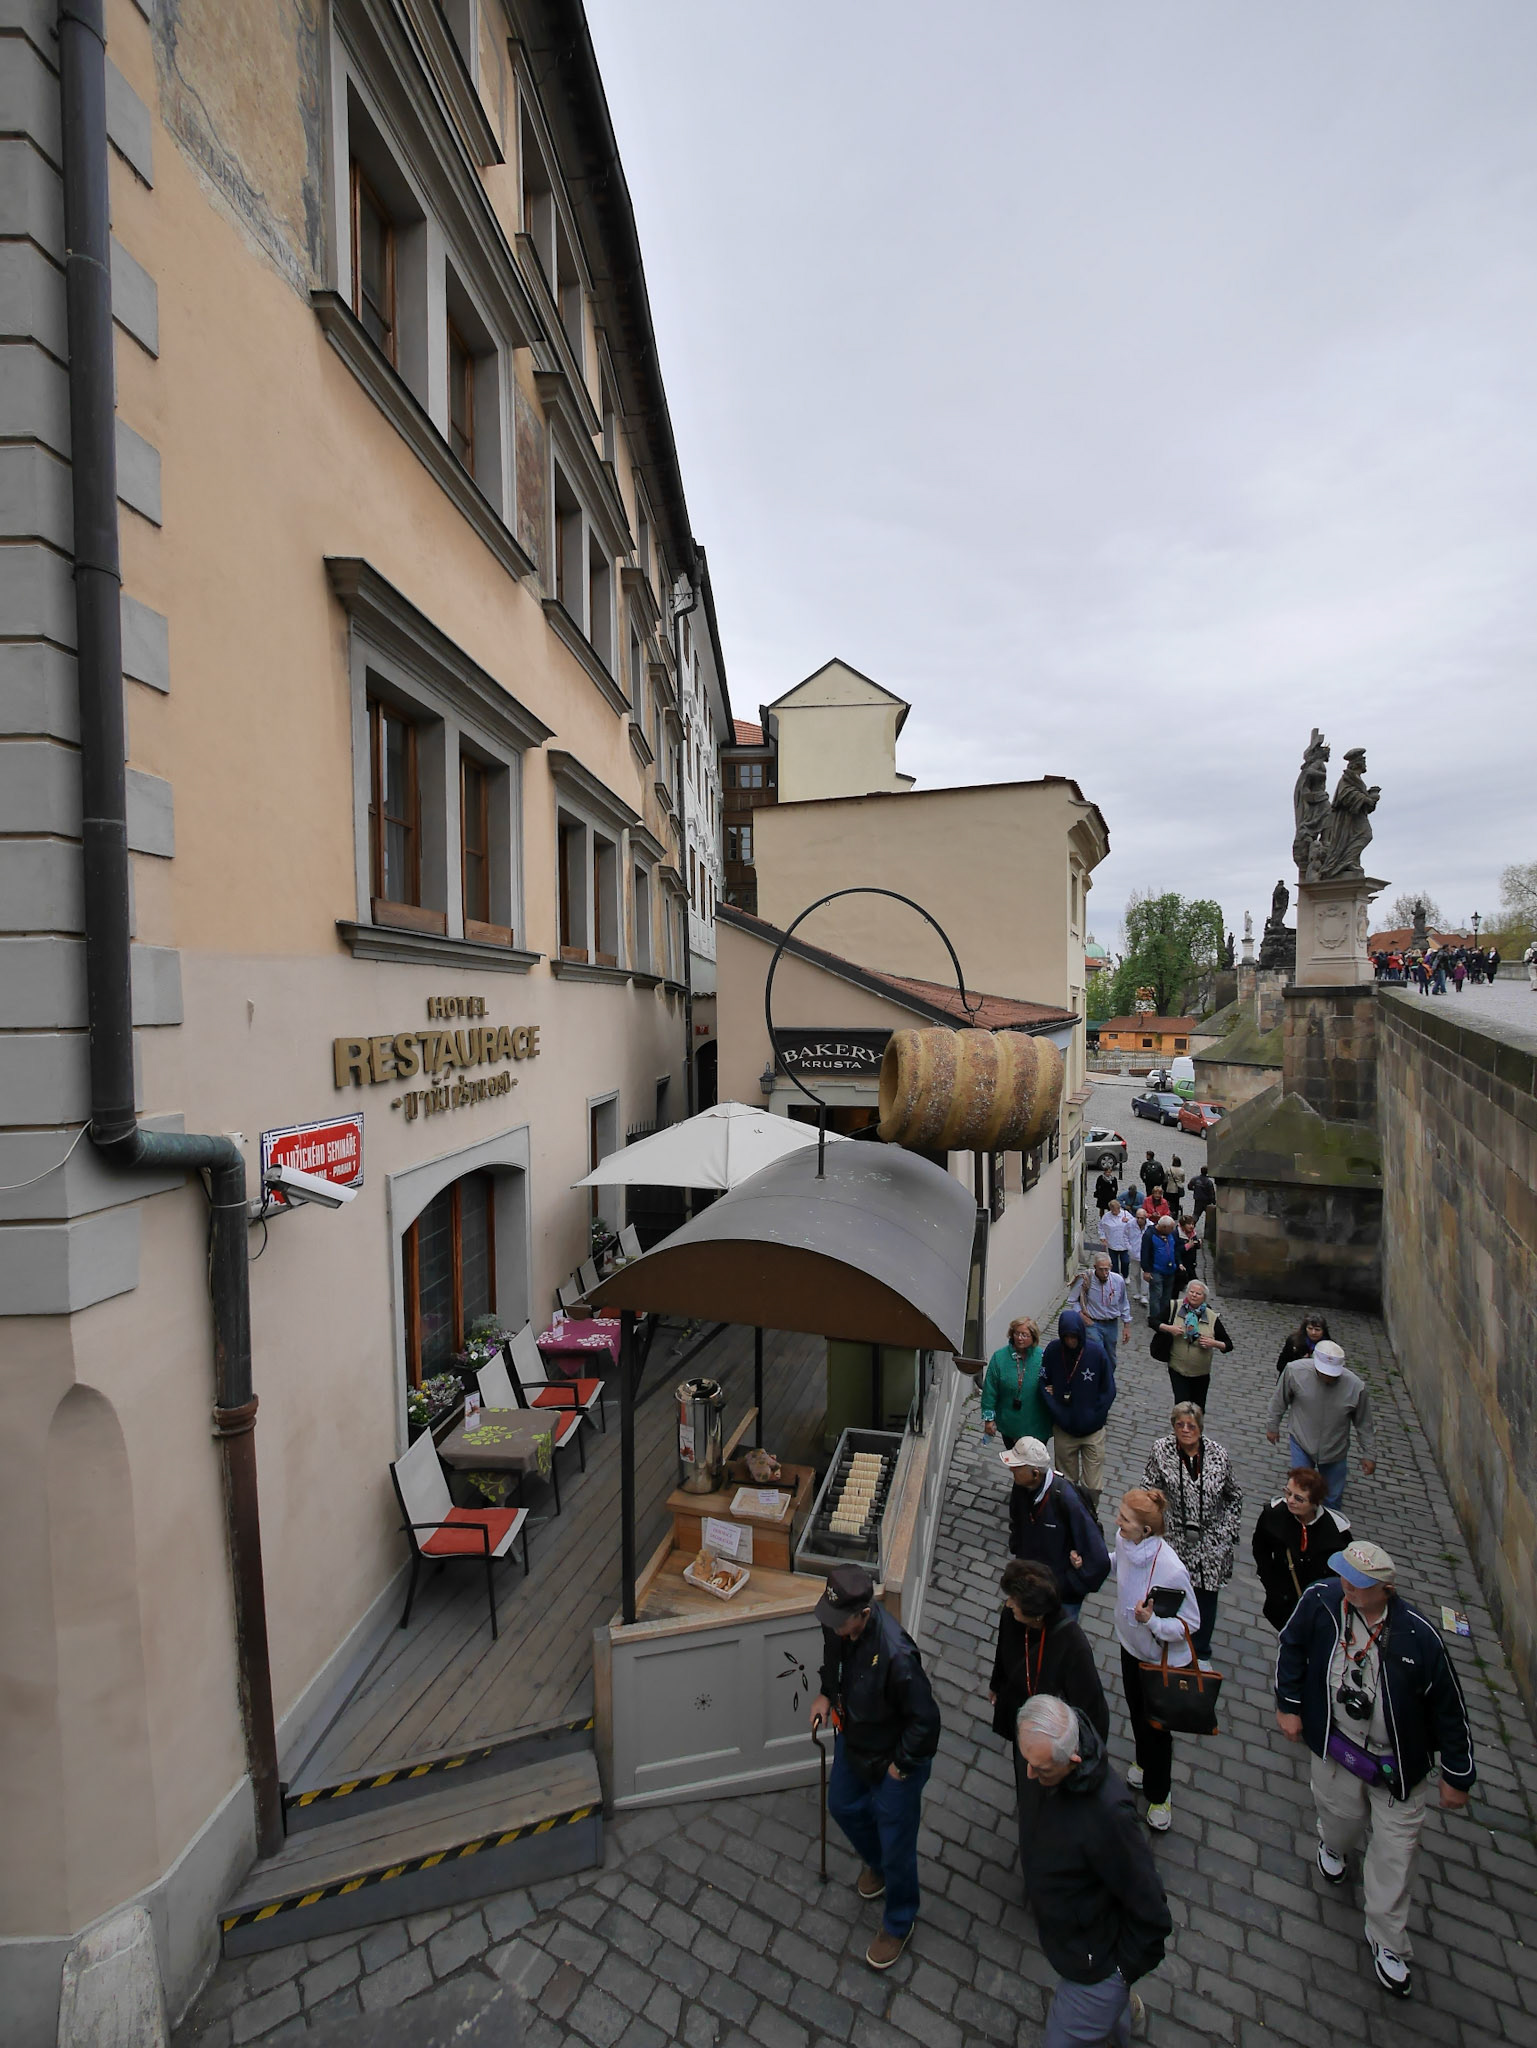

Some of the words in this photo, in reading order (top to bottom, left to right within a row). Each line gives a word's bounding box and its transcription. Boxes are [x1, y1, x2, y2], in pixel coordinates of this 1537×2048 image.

[428, 996, 490, 1018] HOTEL
[334, 1025, 541, 1088] RESTAURACE
[781, 1043, 884, 1064] BAKERY
[801, 1060, 862, 1069] KRUSTA
